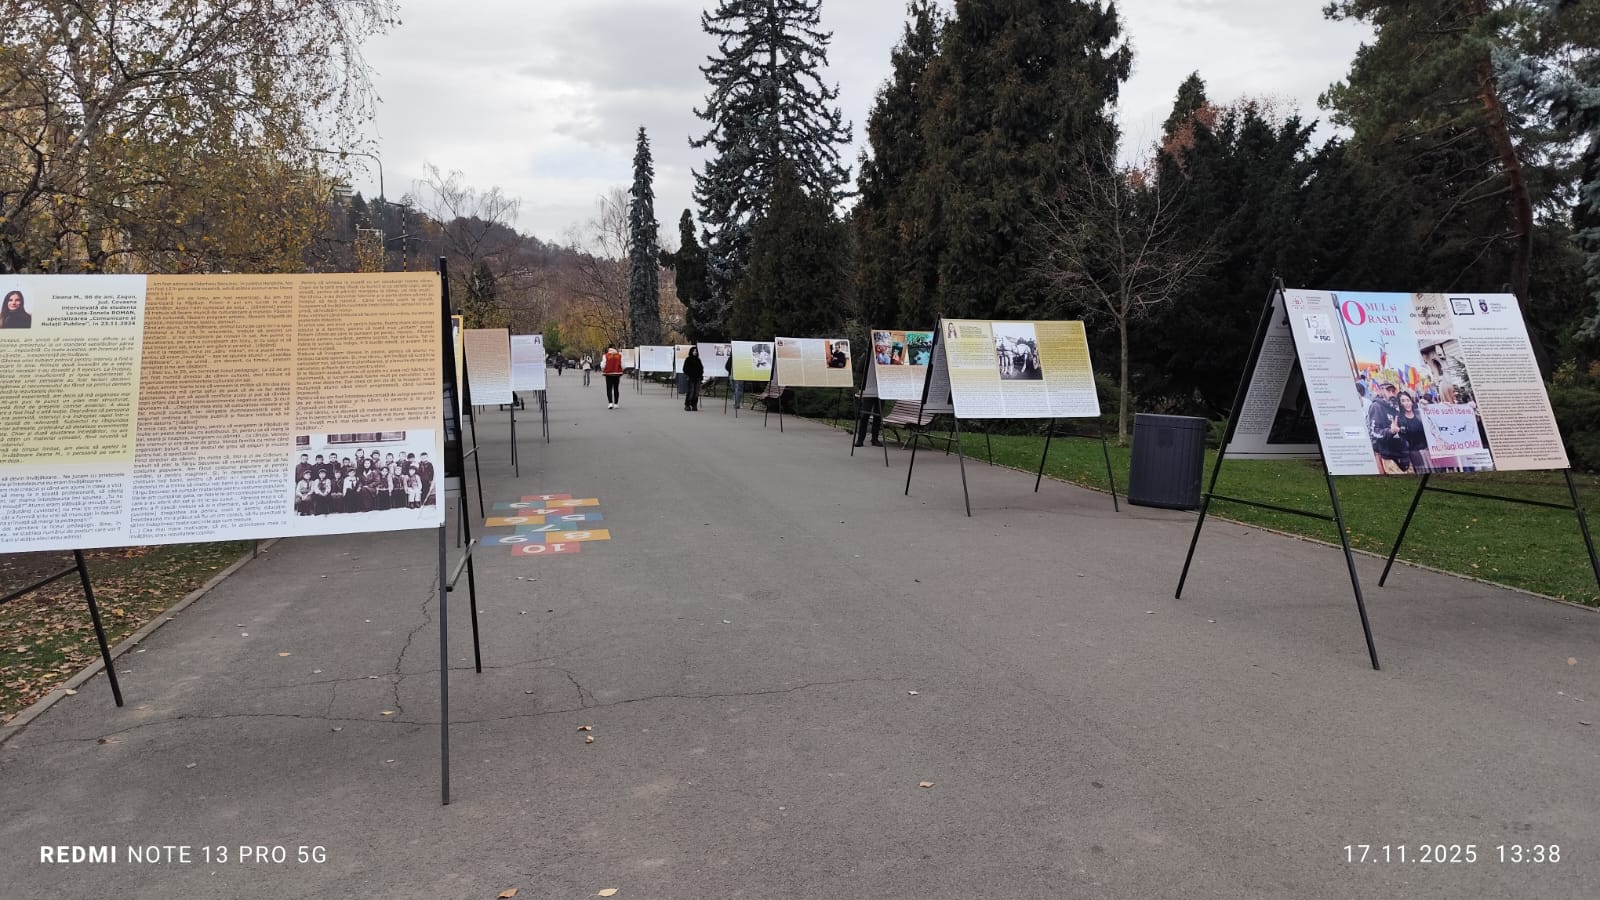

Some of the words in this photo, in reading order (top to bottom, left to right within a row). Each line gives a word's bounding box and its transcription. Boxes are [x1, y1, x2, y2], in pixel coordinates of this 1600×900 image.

[532, 524, 560, 532] 7
[564, 532, 591, 540] 8
[522, 543, 566, 554] 10
